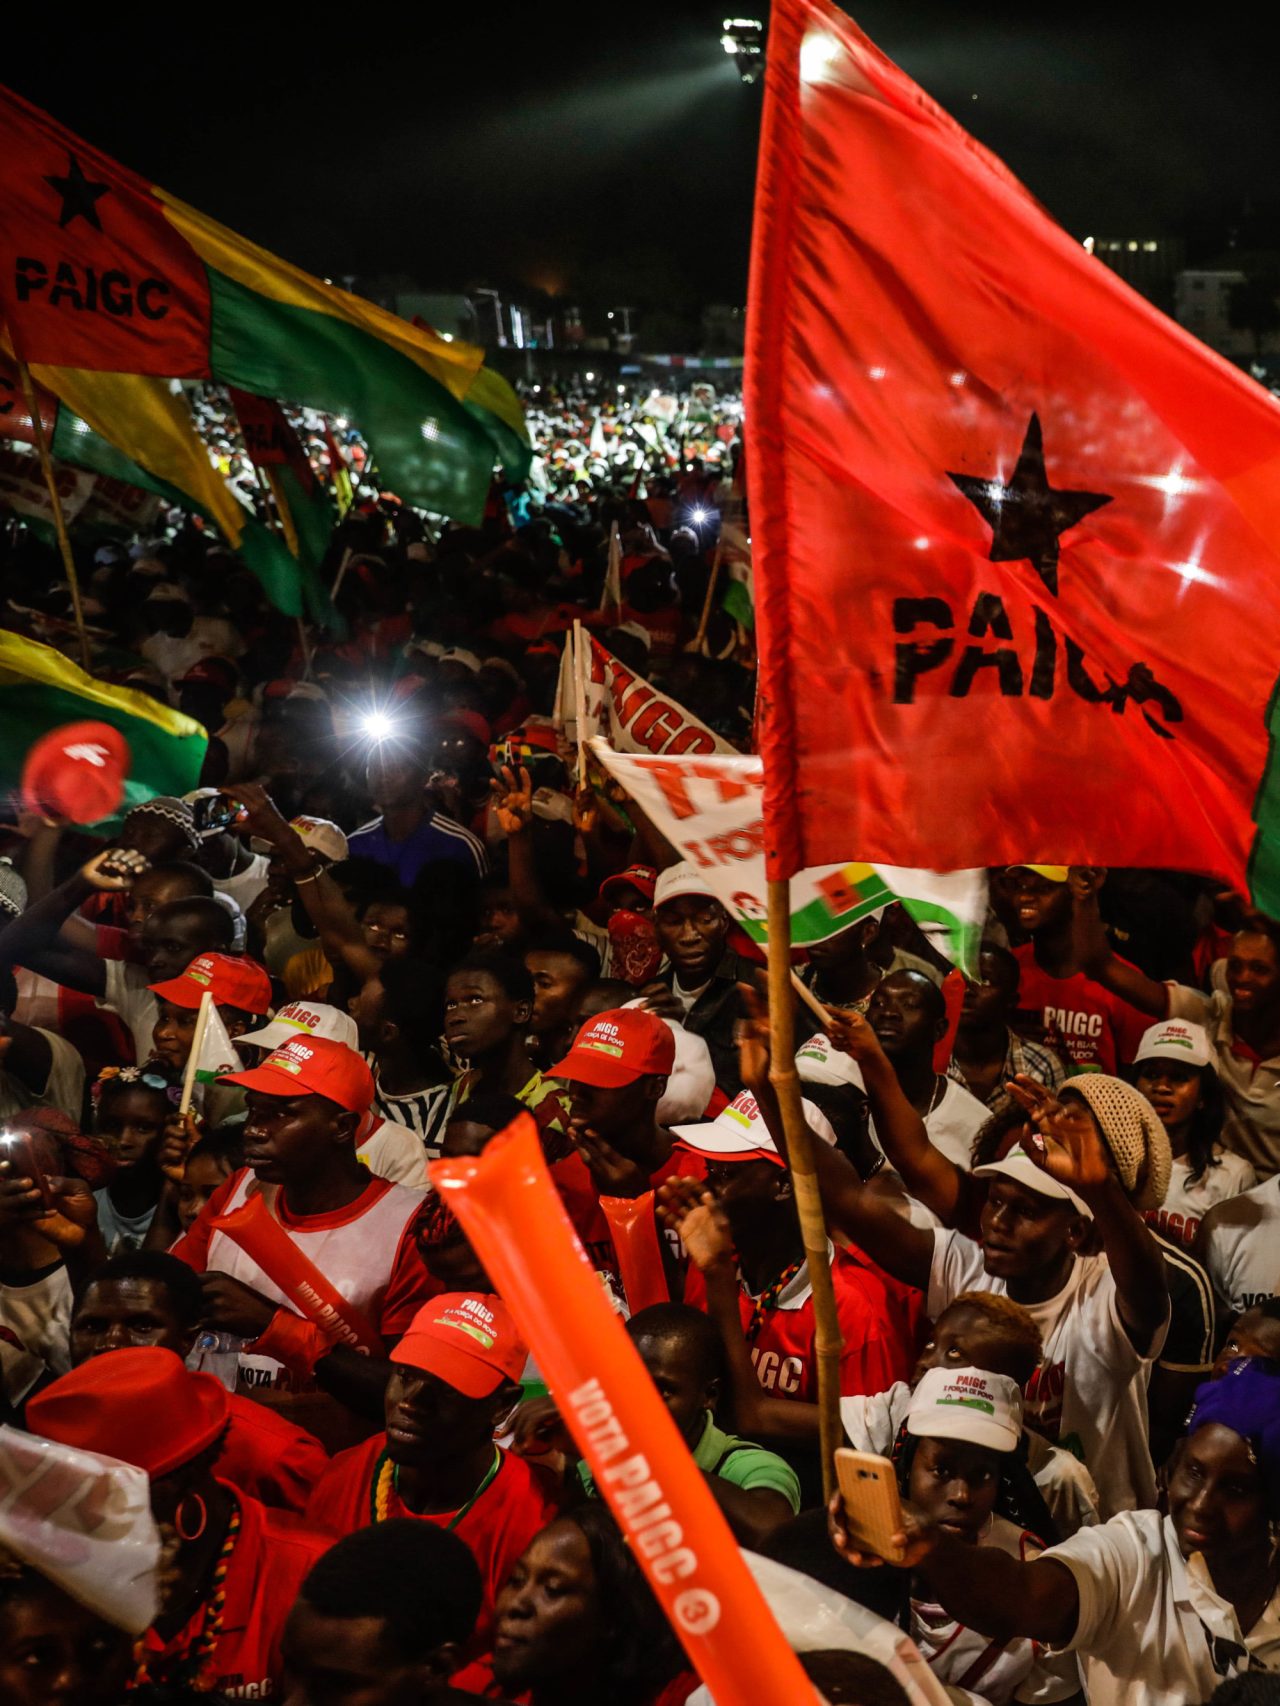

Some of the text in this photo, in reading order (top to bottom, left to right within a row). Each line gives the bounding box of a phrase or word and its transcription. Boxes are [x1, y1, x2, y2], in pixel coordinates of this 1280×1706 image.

[16, 257, 169, 320] PAIGC
[1044, 1006, 1102, 1037] PAIGC
[1144, 1209, 1200, 1243] AIGC
[296, 1281, 358, 1344] VOTA PAIGC
[461, 1299, 494, 1323] PAIGC
[482, 1323, 497, 1338] POVO
[751, 1348, 802, 1394] IGC
[957, 1375, 987, 1390] PAIGC
[977, 1390, 994, 1400] POVO
[569, 1378, 629, 1462] VOTA
[603, 1453, 698, 1584] PAIGC
[225, 1677, 274, 1700] AIGC
